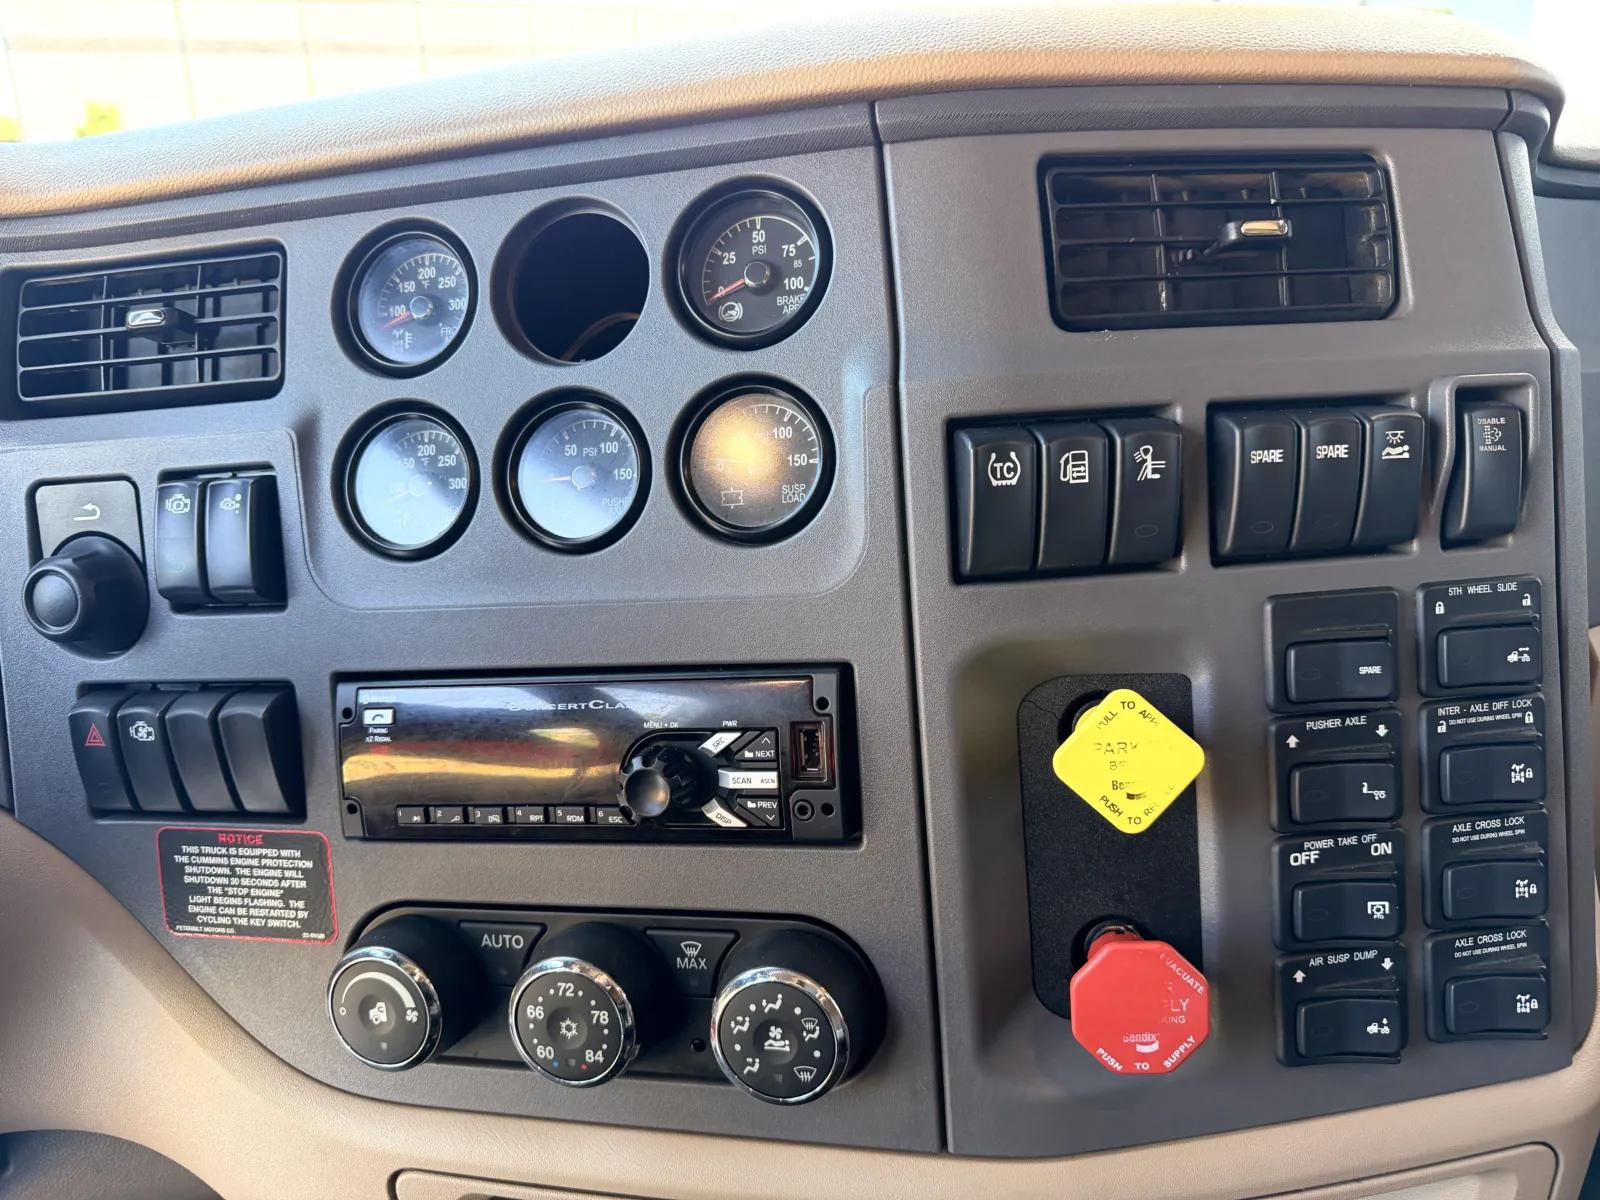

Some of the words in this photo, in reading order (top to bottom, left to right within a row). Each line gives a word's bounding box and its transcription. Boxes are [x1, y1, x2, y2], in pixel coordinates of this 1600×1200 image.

[752, 230, 765, 243] 50
[752, 245, 767, 255] PSI
[782, 244, 796, 258] 75
[722, 252, 736, 265] 25
[793, 260, 802, 268] 85
[418, 267, 436, 279] 200
[399, 281, 416, 293] 150
[438, 276, 456, 289] 250
[783, 277, 804, 291] 100
[448, 298, 466, 310] 300
[389, 305, 406, 317] 100
[773, 427, 793, 439] 100
[417, 444, 436, 456] 200
[564, 444, 577, 457] 50
[600, 442, 619, 454] 100
[1316, 444, 1349, 459] SPARE
[438, 455, 456, 467] 250
[788, 454, 808, 467] 150
[1250, 449, 1284, 464] SPARE
[613, 468, 632, 480] 150
[993, 462, 1014, 479] TC
[448, 478, 468, 490] 300
[782, 483, 806, 494] SUSP
[782, 493, 805, 504] LOAD
[1448, 587, 1463, 596] 5TH
[1467, 585, 1493, 595] WHEEL
[1497, 582, 1518, 592] SLIDE
[1359, 666, 1382, 675] SPARE
[1120, 701, 1136, 710] TO
[1437, 706, 1461, 716] INTER
[1469, 703, 1490, 713] AXLE
[1492, 701, 1509, 710] DIFF
[1512, 698, 1533, 708] LOCK
[1306, 718, 1342, 730] PUSHER
[1344, 716, 1367, 727] AXLE
[712, 737, 726, 749] SRC
[757, 801, 777, 809] PREV
[1099, 795, 1124, 818] PUSH
[1127, 817, 1142, 825] TO
[530, 815, 544, 823] RPT
[716, 812, 732, 824] DISP
[1452, 823, 1472, 833] AXLE
[1475, 819, 1502, 830] CROSS
[1504, 816, 1525, 827] LOCK
[217, 833, 264, 845] NOTICE
[1304, 838, 1334, 850] POWER
[1337, 836, 1358, 846] TAKE
[1361, 833, 1378, 844] OFF
[181, 845, 200, 854] THIS
[200, 846, 228, 855] TRUCK
[229, 847, 237, 855] IS
[238, 848, 279, 857] EQUIPPED
[280, 849, 301, 858] WITH
[1370, 842, 1392, 856] ON
[173, 855, 190, 863] THE
[190, 856, 229, 865] CUMMINS
[230, 857, 260, 866] ENGINE
[261, 858, 314, 869] PROTECTION
[1289, 850, 1320, 866] OFF
[235, 867, 252, 876] THE
[252, 868, 283, 877] ENGINE
[284, 869, 304, 878] WILL
[183, 875, 229, 885] SHUTDOWN
[230, 877, 240, 885] 30
[240, 877, 280, 887] SECONDS
[280, 879, 307, 889] AFTER
[207, 886, 224, 894] THE
[189, 895, 212, 903] LIGHT
[213, 896, 243, 905] BEGINS
[244, 898, 286, 908] FLASHING.
[288, 899, 306, 908] THE
[188, 904, 217, 914] ENGINE
[218, 906, 236, 915] CAN
[237, 907, 248, 915] BE
[249, 908, 296, 919] RESTARTED
[297, 910, 309, 919] BY
[196, 915, 232, 924] CYCLING
[232, 917, 249, 925] THE
[249, 918, 267, 927] KEY
[267, 919, 302, 928] SWITCH.
[481, 933, 524, 949] AUTO
[1454, 937, 1474, 948] AXLE
[1477, 932, 1503, 944] CROSS
[1506, 929, 1527, 940] LOCK
[676, 957, 708, 970] MAX
[1308, 957, 1324, 967] AIR
[1327, 953, 1350, 965] SUSP
[1353, 949, 1378, 961] DUMP
[557, 982, 575, 997] 72
[526, 1005, 544, 1019] 66
[591, 1010, 609, 1025] 78
[536, 1045, 554, 1059] 60
[585, 1050, 604, 1063] 84
[1096, 1047, 1123, 1071] PUSH
[1134, 1062, 1150, 1071] TO
[1163, 1035, 1196, 1068] SUPPLY
